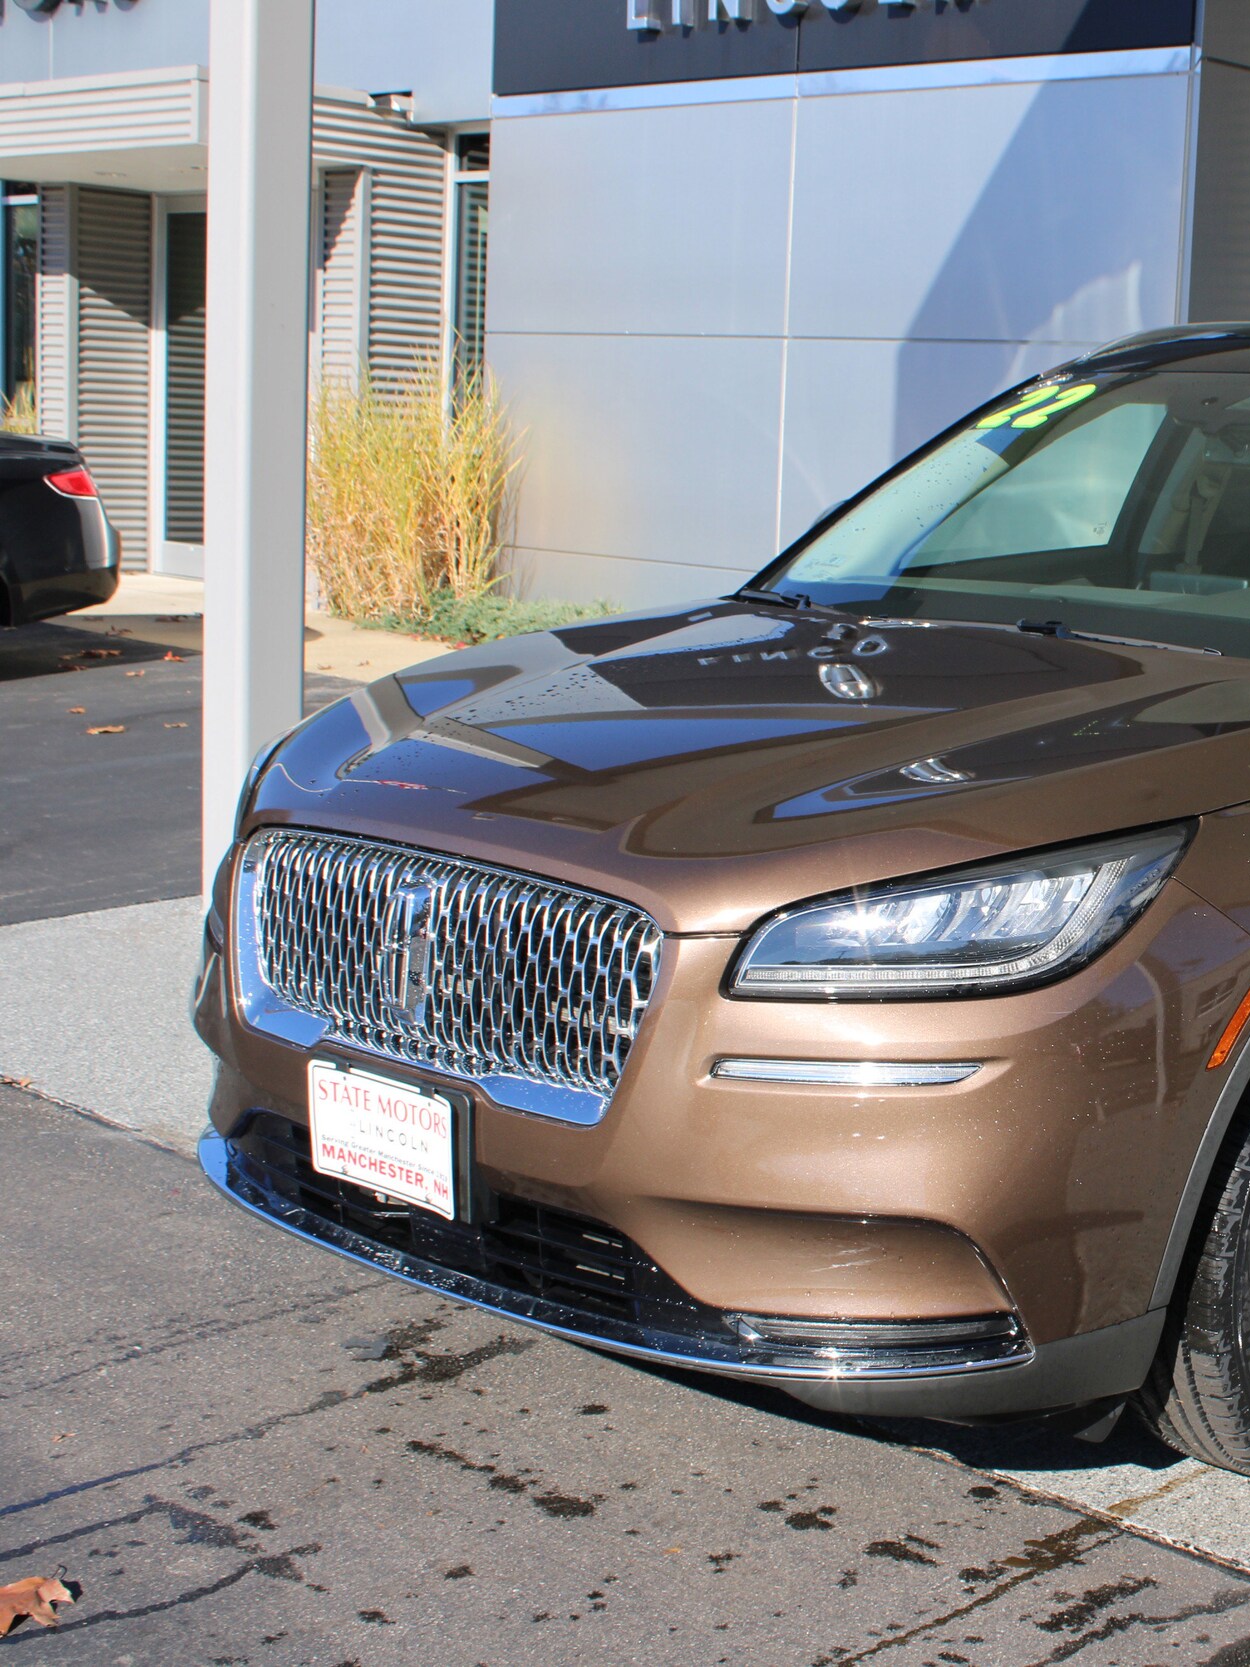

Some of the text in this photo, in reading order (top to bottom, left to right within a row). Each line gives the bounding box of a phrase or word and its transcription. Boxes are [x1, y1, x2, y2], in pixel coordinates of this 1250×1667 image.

[974, 384, 1097, 429] 22
[318, 1079, 447, 1139] STATE MOTORS
[321, 1134, 349, 1147] Serving
[351, 1141, 376, 1154] Greater
[378, 1150, 416, 1168] Manchester
[359, 1119, 429, 1153] LINCOLN
[433, 1178, 449, 1200] NH
